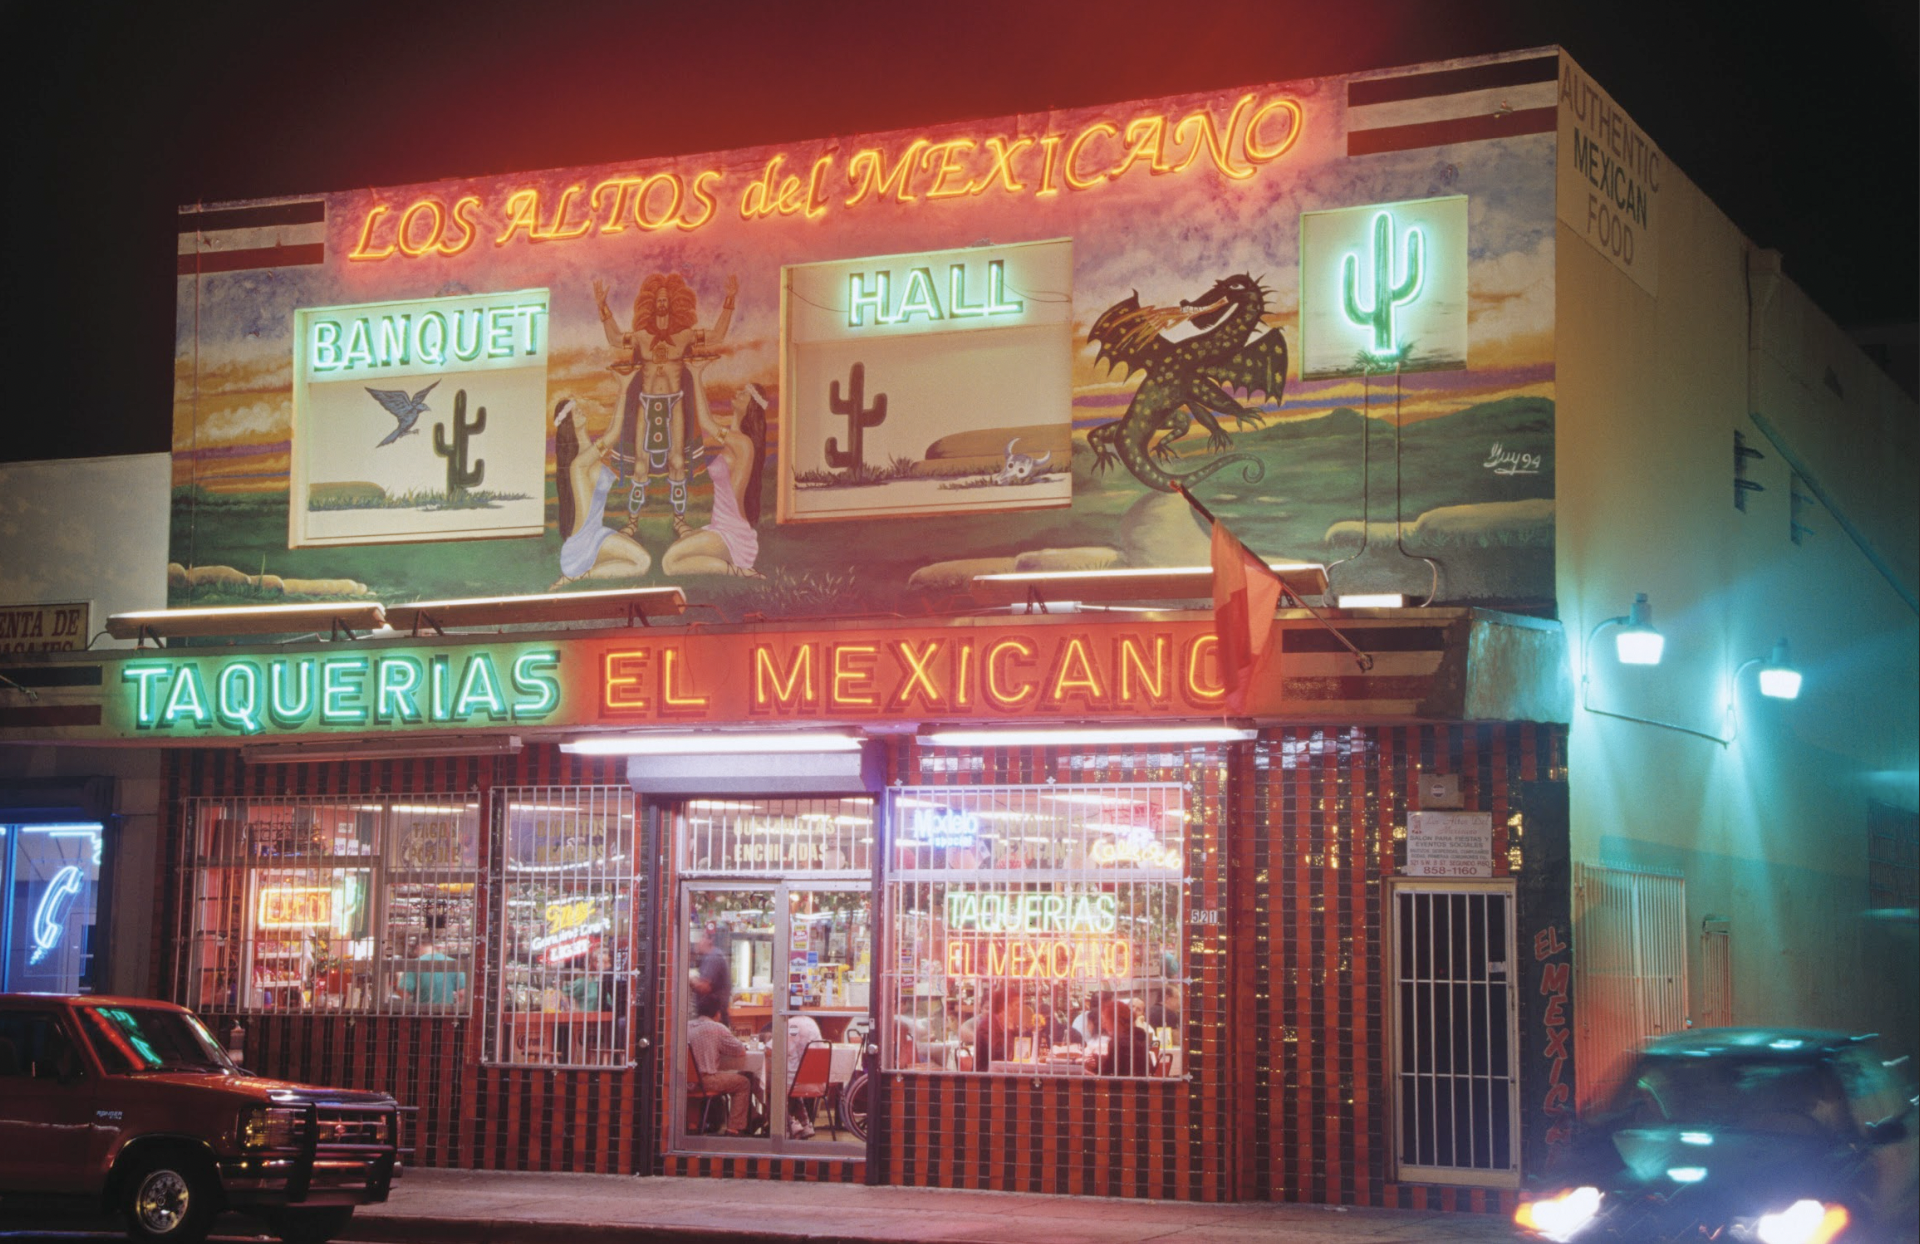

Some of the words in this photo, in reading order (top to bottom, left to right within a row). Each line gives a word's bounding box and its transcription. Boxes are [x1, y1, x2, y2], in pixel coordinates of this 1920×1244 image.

[1561, 63, 1660, 193] AUTHENTIC
[348, 195, 481, 262] LOS
[495, 170, 723, 247] ALTOS
[740, 153, 834, 221] del
[845, 93, 1303, 209] MEXICANO
[1573, 126, 1648, 231] MEXICAN
[1587, 193, 1634, 266] FOOD
[847, 259, 1024, 328] HALL
[313, 302, 547, 373] BANQUET
[0, 611, 43, 638] ENTA
[52, 610, 80, 636] DE
[121, 648, 561, 734] TAQUERIAS
[599, 646, 711, 719] EL
[914, 809, 977, 838] Modelo
[734, 843, 829, 862] ENCHILADAS
[1423, 866, 1477, 875] 858-1160
[267, 893, 326, 921] OPEN
[947, 893, 1116, 934] TAQUERIAS
[1192, 910, 1215, 923] 521
[948, 941, 979, 978] EL
[986, 941, 1130, 978] MEXICANO
[1534, 926, 1567, 961] EL
